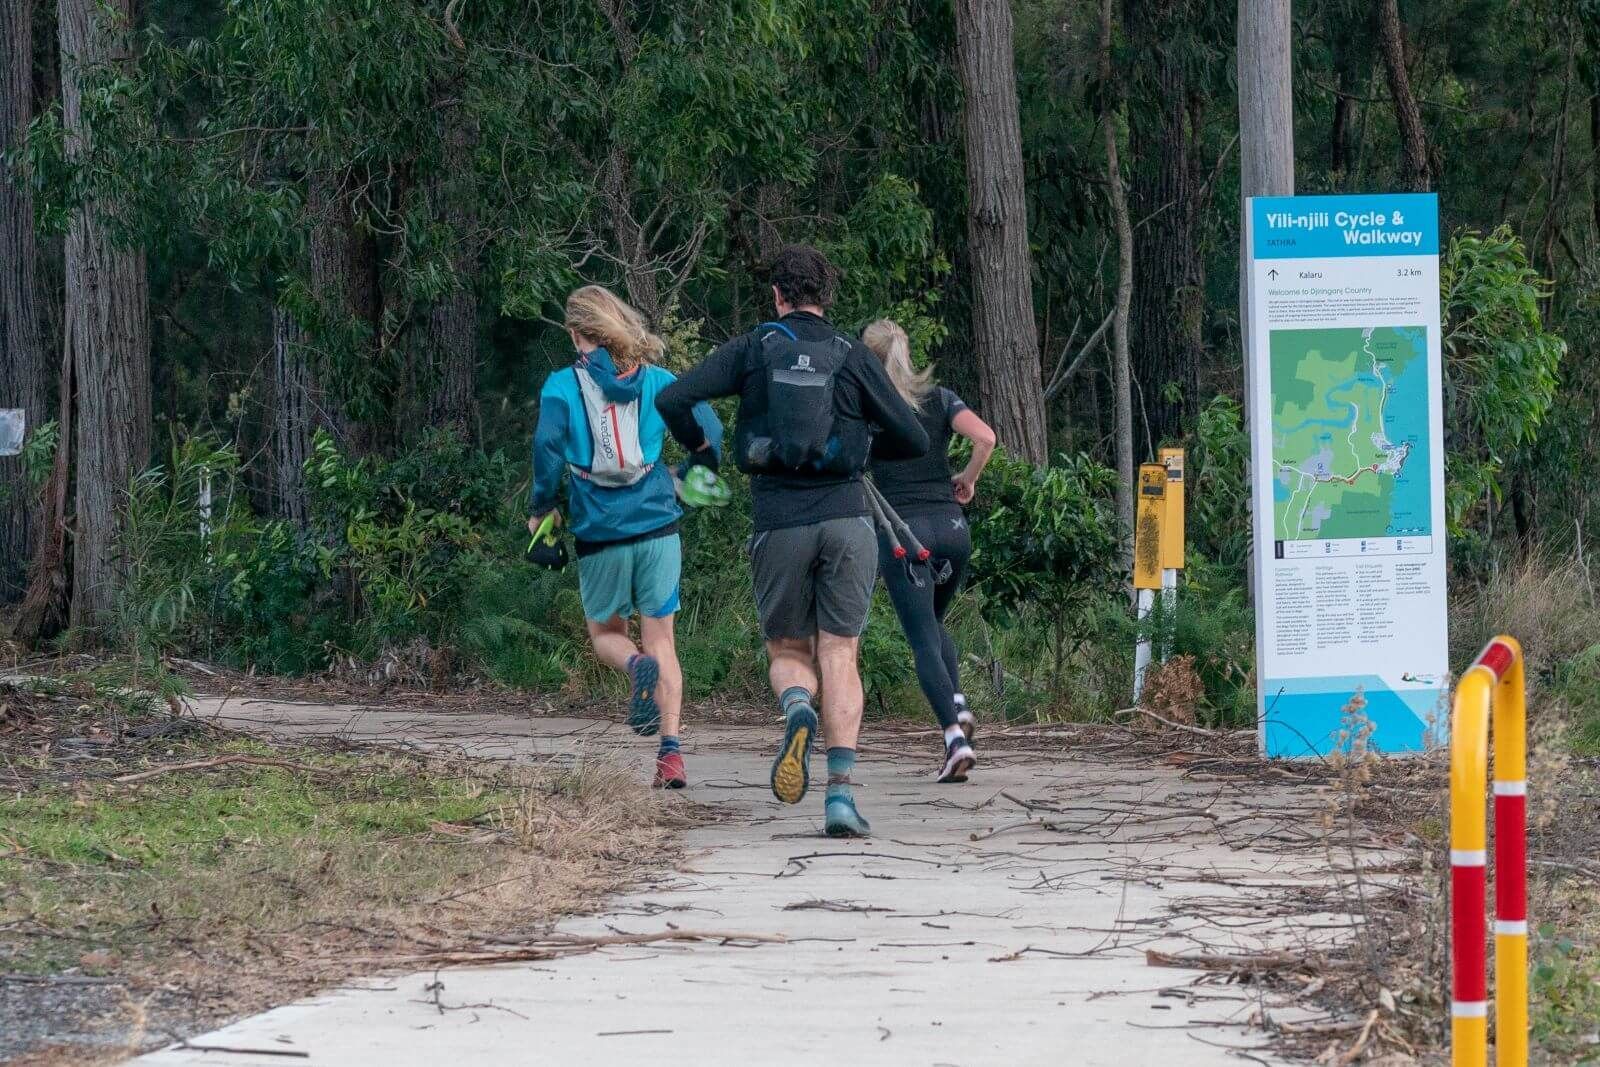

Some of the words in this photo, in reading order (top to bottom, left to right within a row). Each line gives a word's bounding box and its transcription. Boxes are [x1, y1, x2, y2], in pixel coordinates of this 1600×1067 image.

[1267, 211, 1329, 231] Yili-njili
[1335, 211, 1386, 230] Cycle
[1392, 210, 1404, 226] &
[1343, 229, 1423, 246] Walkway
[1267, 239, 1297, 248] TATHRA
[1299, 271, 1323, 279] Kalaru
[1397, 268, 1408, 277] 3.2
[1410, 268, 1422, 276] km
[1268, 288, 1300, 297] Welcome
[1302, 288, 1309, 296] to
[1344, 286, 1373, 296] Country
